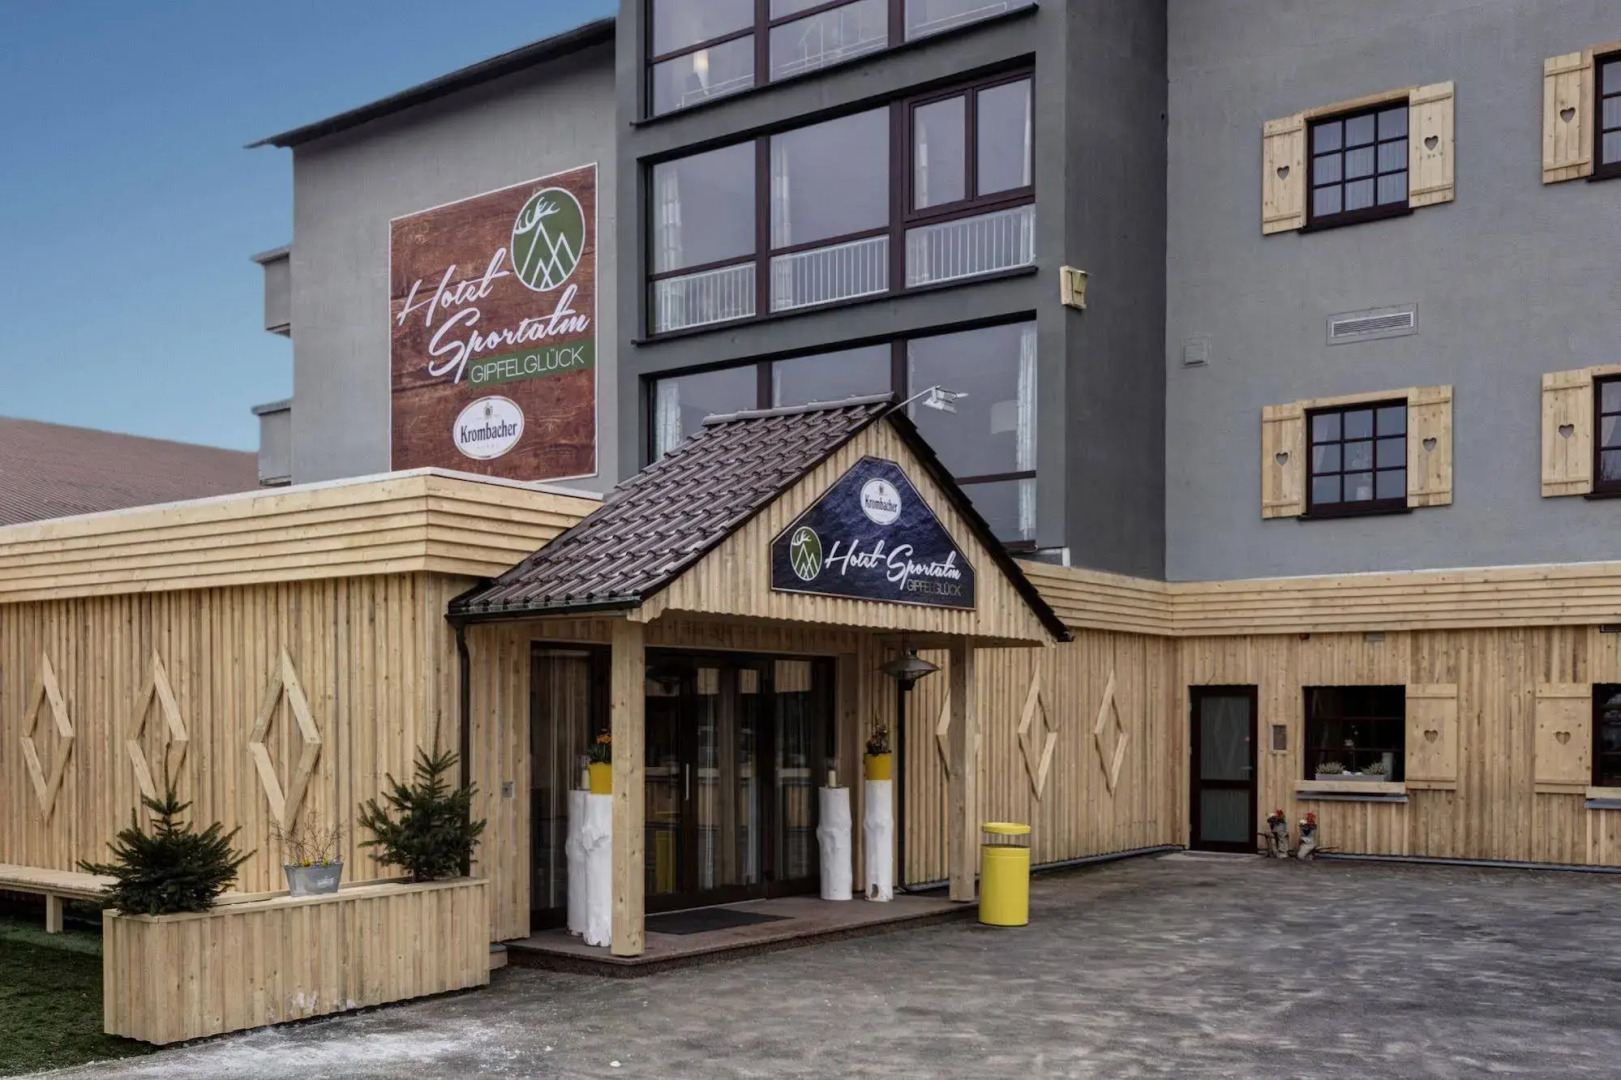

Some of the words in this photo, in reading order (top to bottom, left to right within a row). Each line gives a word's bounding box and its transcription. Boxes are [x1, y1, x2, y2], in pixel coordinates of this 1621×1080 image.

[397, 248, 510, 327] Hotel
[429, 284, 590, 384] Sportalm
[471, 346, 584, 383] GIPFELGLÜCK
[461, 420, 517, 443] Krombacher
[865, 494, 897, 512] Krombacher
[825, 539, 886, 575] Hotel
[887, 544, 961, 590] Sportalm
